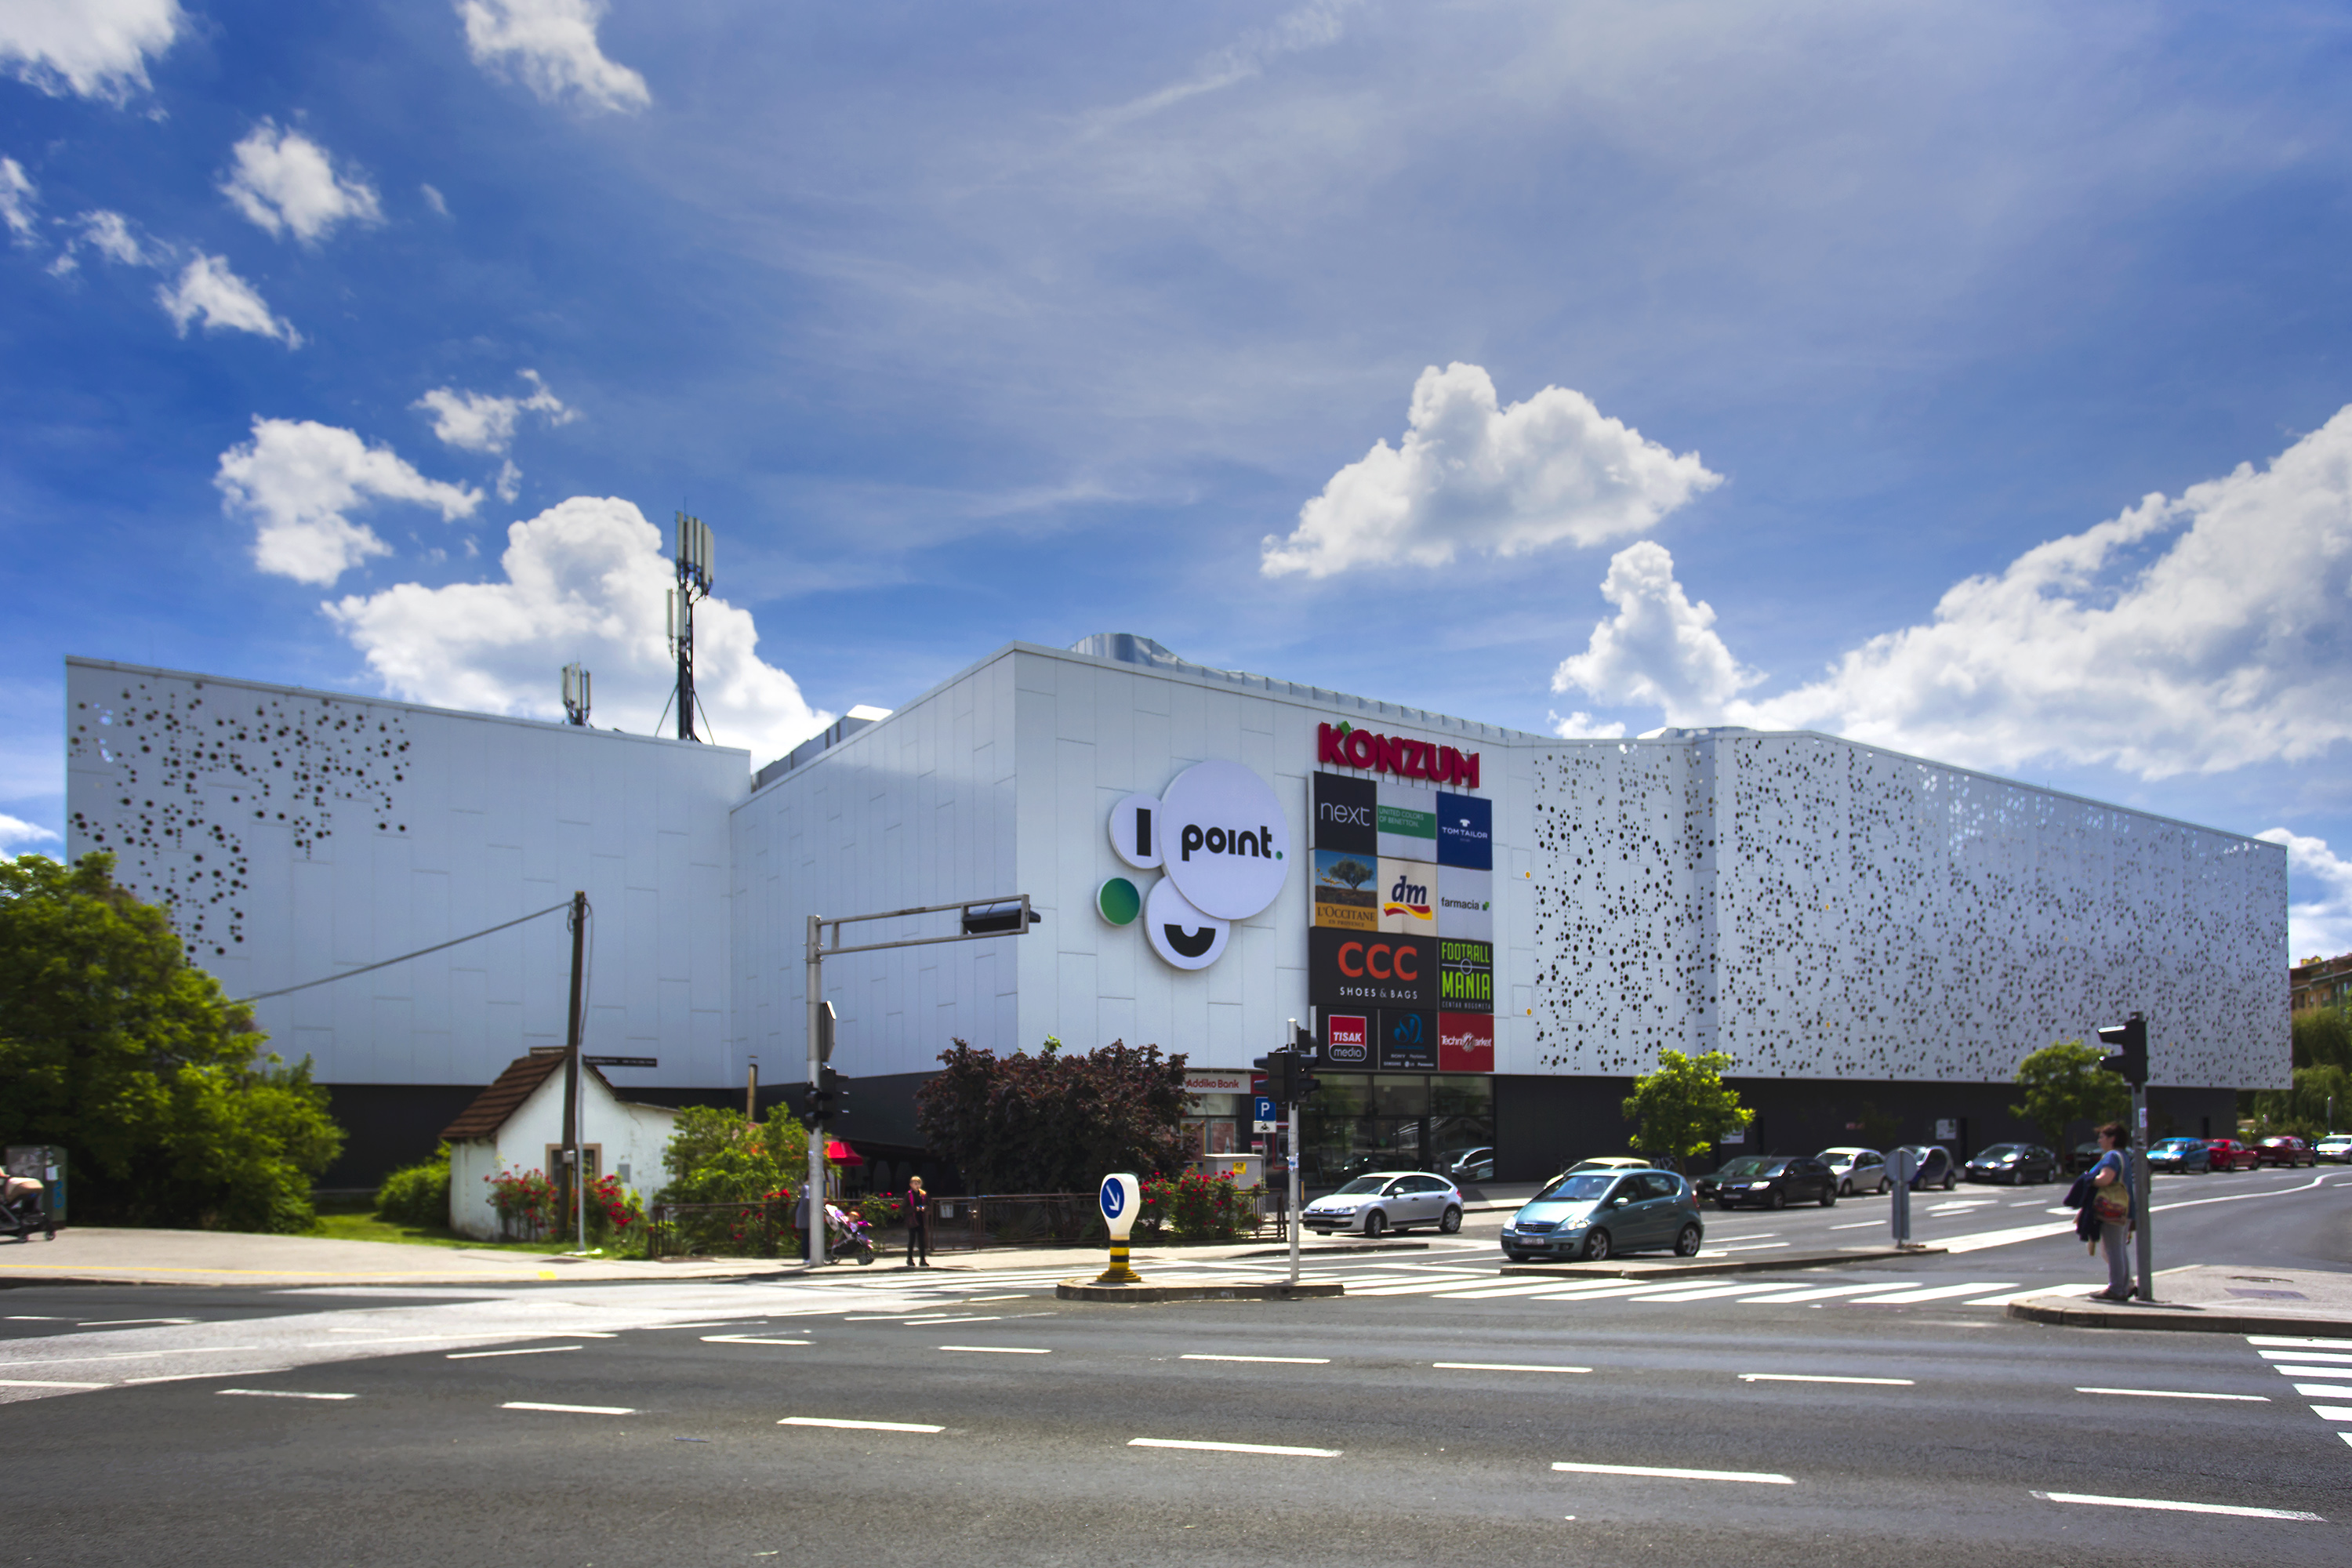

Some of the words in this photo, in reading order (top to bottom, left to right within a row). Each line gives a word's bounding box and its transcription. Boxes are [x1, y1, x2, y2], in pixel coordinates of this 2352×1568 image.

[1318, 721, 1480, 789] KONZUM
[1320, 801, 1370, 826] next
[1460, 829, 1488, 839] TAILOR
[1392, 875, 1427, 905] dm
[1441, 897, 1480, 910] farmacia
[1442, 942, 1490, 963] FOOTBALL
[1338, 942, 1418, 982] CCC
[1339, 986, 1376, 998] SHOES
[1380, 988, 1388, 999] &
[1390, 989, 1418, 1000] BAGS
[1442, 971, 1490, 1000] MANIA
[1333, 1032, 1363, 1043] TISAK
[1334, 1047, 1362, 1058] media
[1186, 1078, 1217, 1088] Addiko
[1218, 1079, 1240, 1088] Bank
[1261, 1102, 1270, 1117] P
